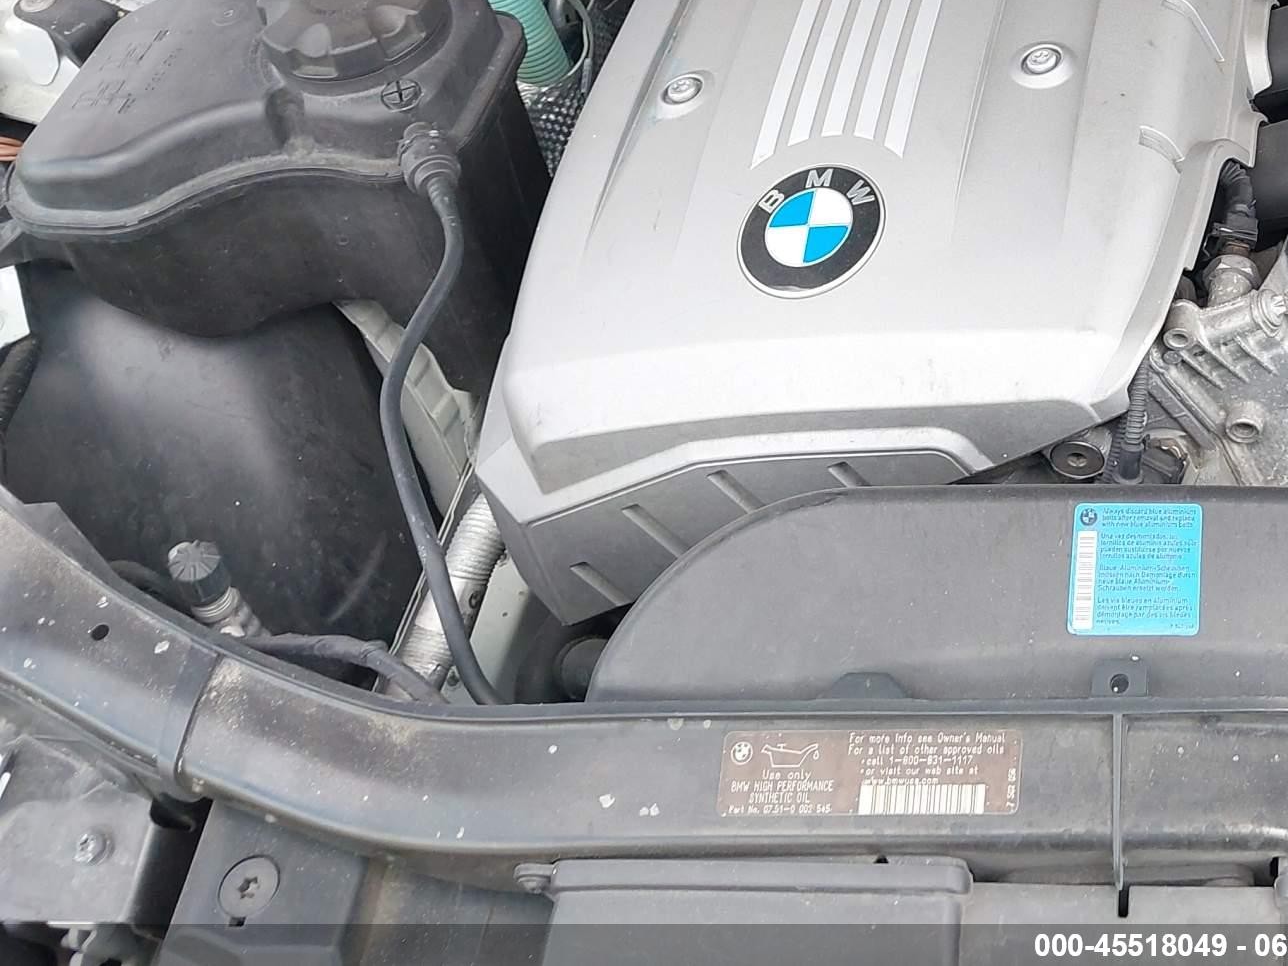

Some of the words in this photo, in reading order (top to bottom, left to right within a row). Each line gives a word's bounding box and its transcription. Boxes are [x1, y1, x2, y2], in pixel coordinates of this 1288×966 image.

[758, 168, 876, 214] BMW
[849, 732, 864, 744] For
[869, 736, 890, 744] more
[938, 732, 970, 743] Owner's
[976, 732, 1005, 743] Manual
[848, 744, 863, 756] For
[901, 744, 910, 754] of
[915, 744, 938, 754] other
[943, 744, 982, 755] approved
[866, 755, 883, 766] call
[762, 770, 781, 780] Use
[787, 769, 812, 783] only
[925, 766, 942, 775] web
[969, 766, 978, 775] at
[731, 781, 750, 793] BMW
[753, 781, 773, 792] HIGH
[777, 780, 834, 792] PERFORMANCE
[749, 792, 793, 804] SYNTHETIC
[796, 792, 811, 803] OIL
